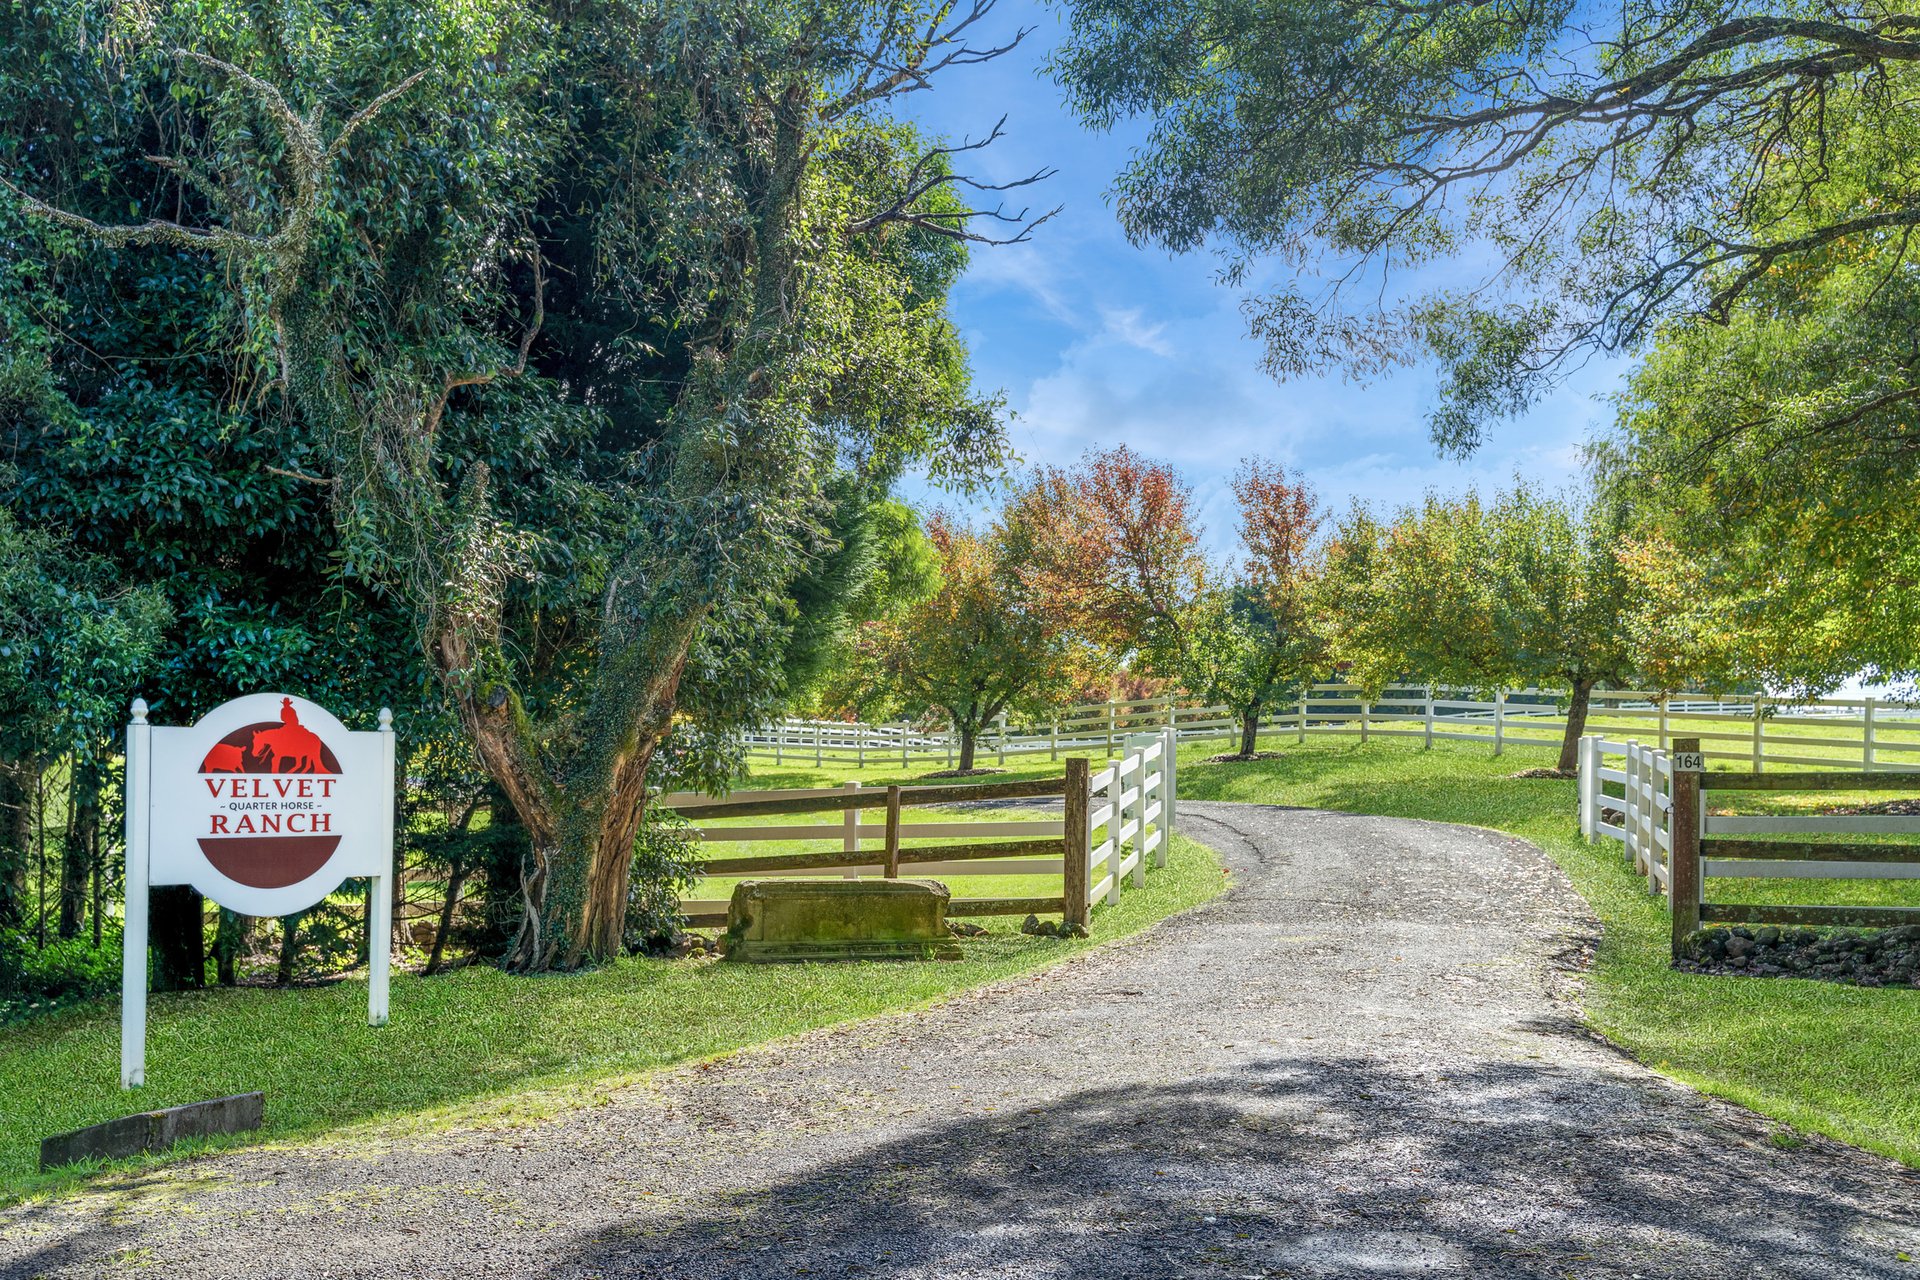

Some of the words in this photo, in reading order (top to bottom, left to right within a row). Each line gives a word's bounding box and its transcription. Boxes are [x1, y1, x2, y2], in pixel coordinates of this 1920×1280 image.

[1676, 754, 1701, 768] 164
[204, 778, 337, 798] VELVET
[229, 802, 278, 811] QUARTER
[280, 801, 314, 810] HORSE
[209, 813, 332, 834] RANCH
